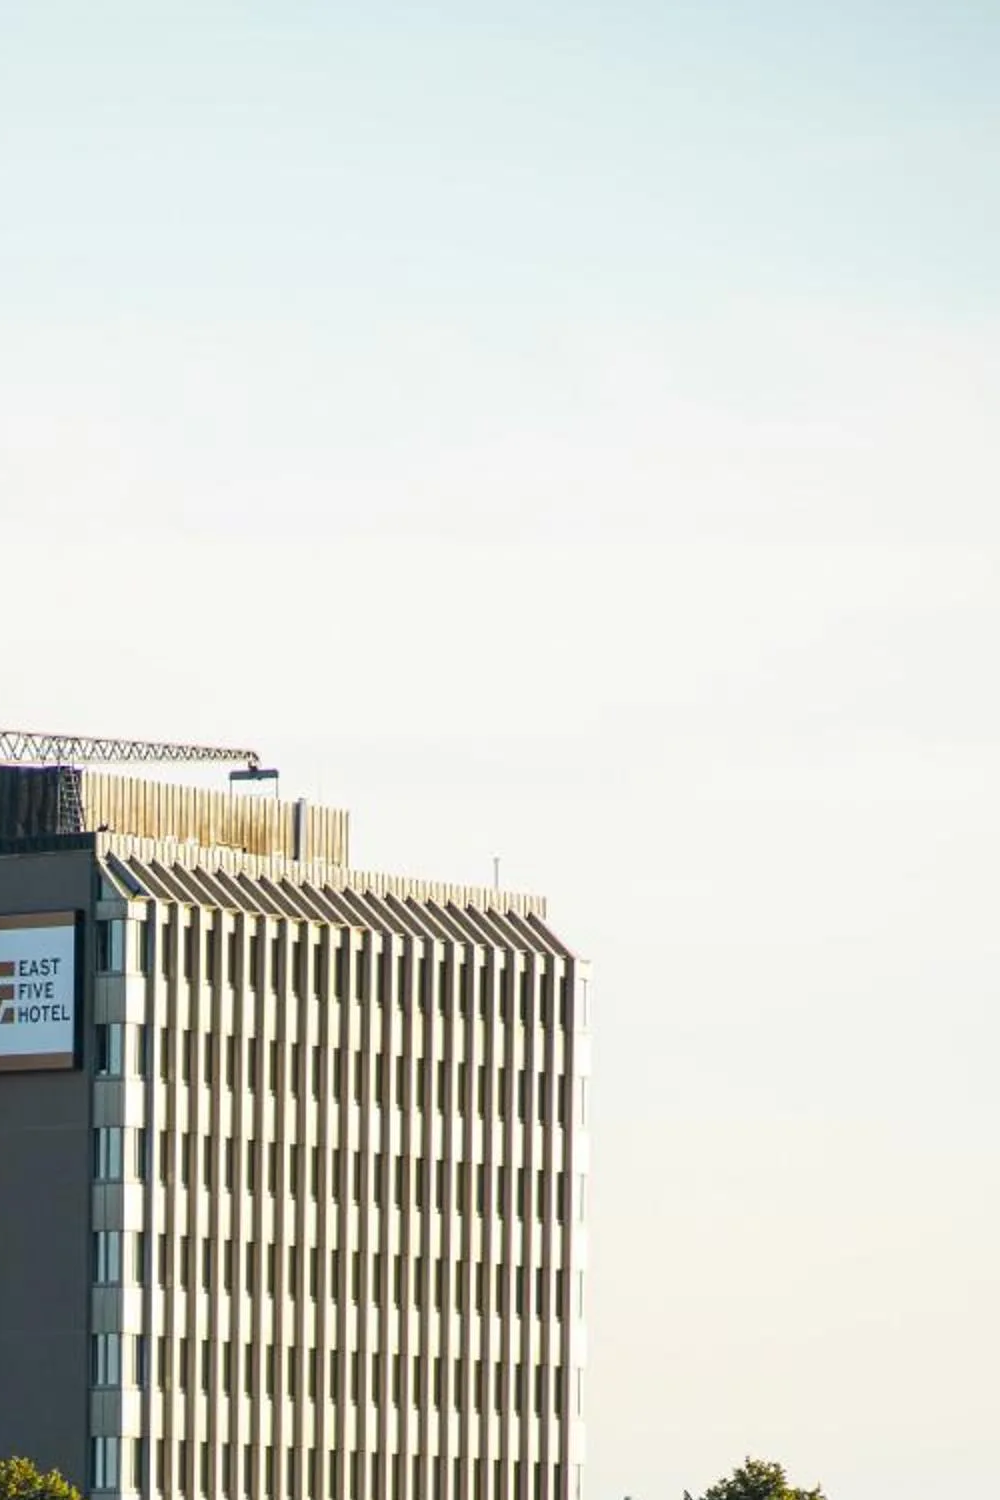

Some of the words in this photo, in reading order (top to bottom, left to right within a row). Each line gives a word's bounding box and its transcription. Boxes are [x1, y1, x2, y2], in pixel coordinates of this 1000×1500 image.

[19, 958, 61, 976] EAST
[19, 982, 54, 1000] FIVE
[18, 1004, 71, 1023] HOTEL
